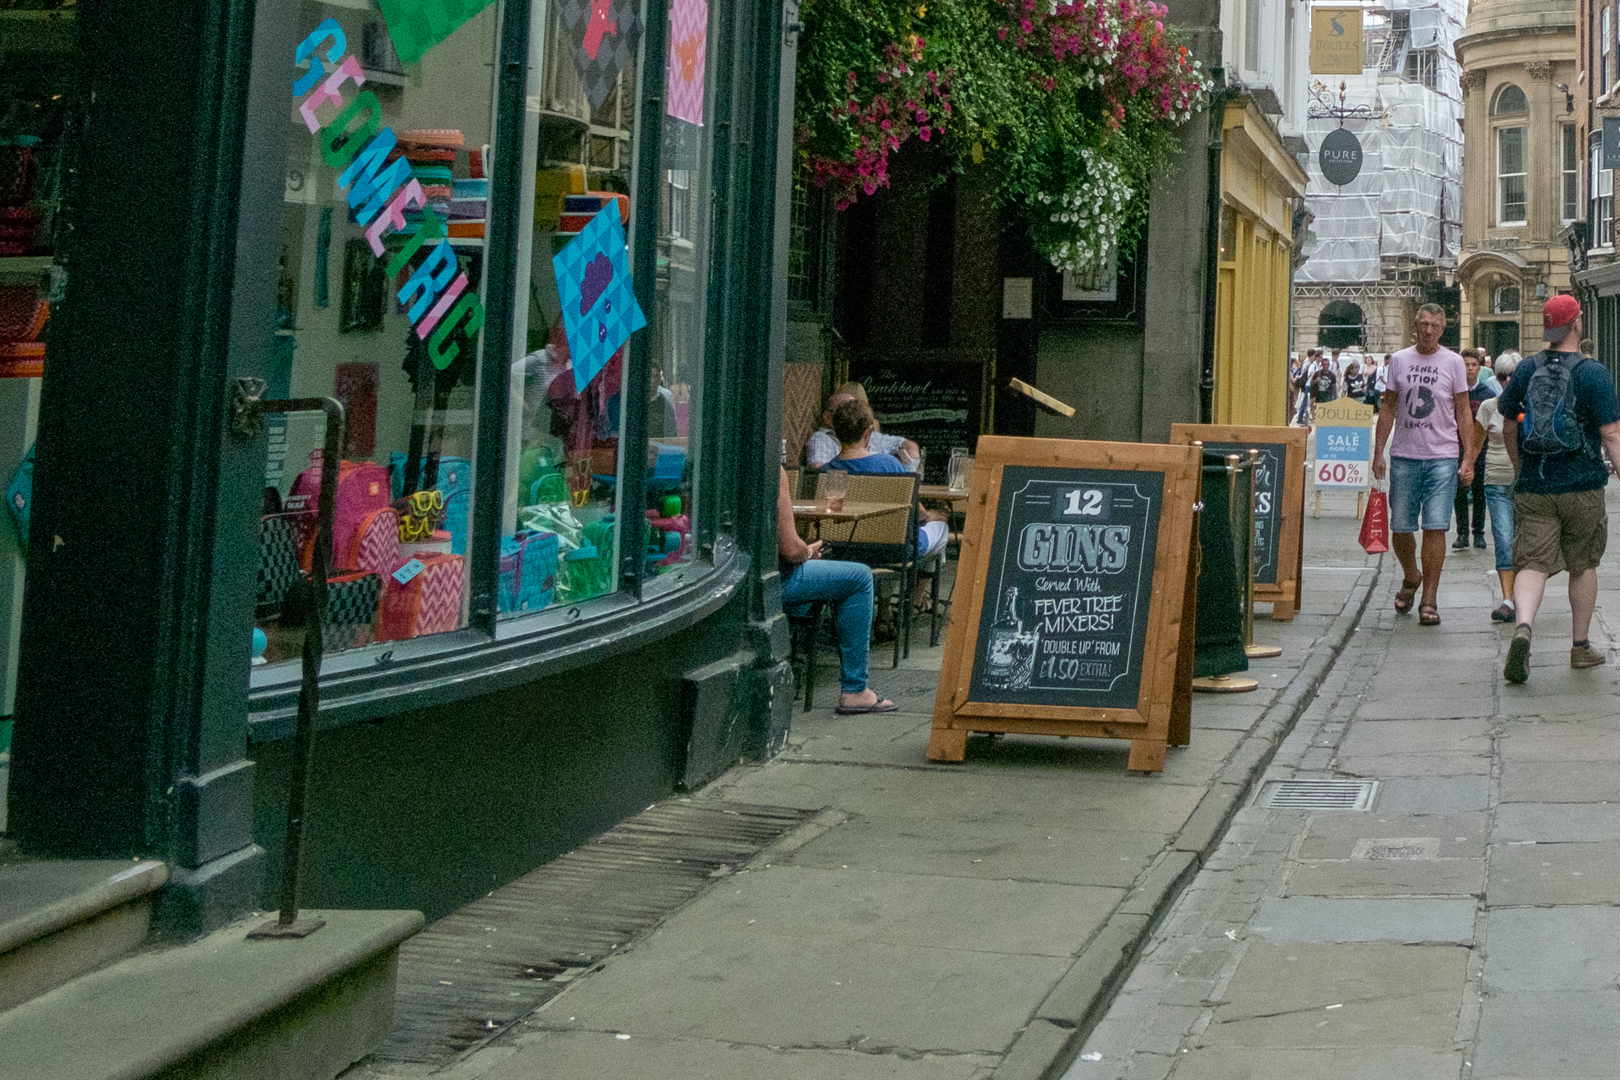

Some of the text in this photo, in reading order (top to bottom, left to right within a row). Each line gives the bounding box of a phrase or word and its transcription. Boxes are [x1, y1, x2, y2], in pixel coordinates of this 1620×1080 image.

[1316, 40, 1358, 50] JOULES
[1323, 150, 1357, 159] PURE
[293, 18, 484, 369] GEOMETRIC
[1317, 406, 1371, 420] JOULES
[1328, 433, 1359, 446] SALE
[1063, 490, 1103, 515] 12
[1371, 498, 1382, 539] SALE
[1018, 523, 1130, 574] GINS
[1035, 576, 1102, 592] Served With
[1045, 614, 1114, 633] MIXERS!
[1095, 641, 1121, 655] FROM
[1039, 656, 1112, 679] £1.50 EXTRA!
